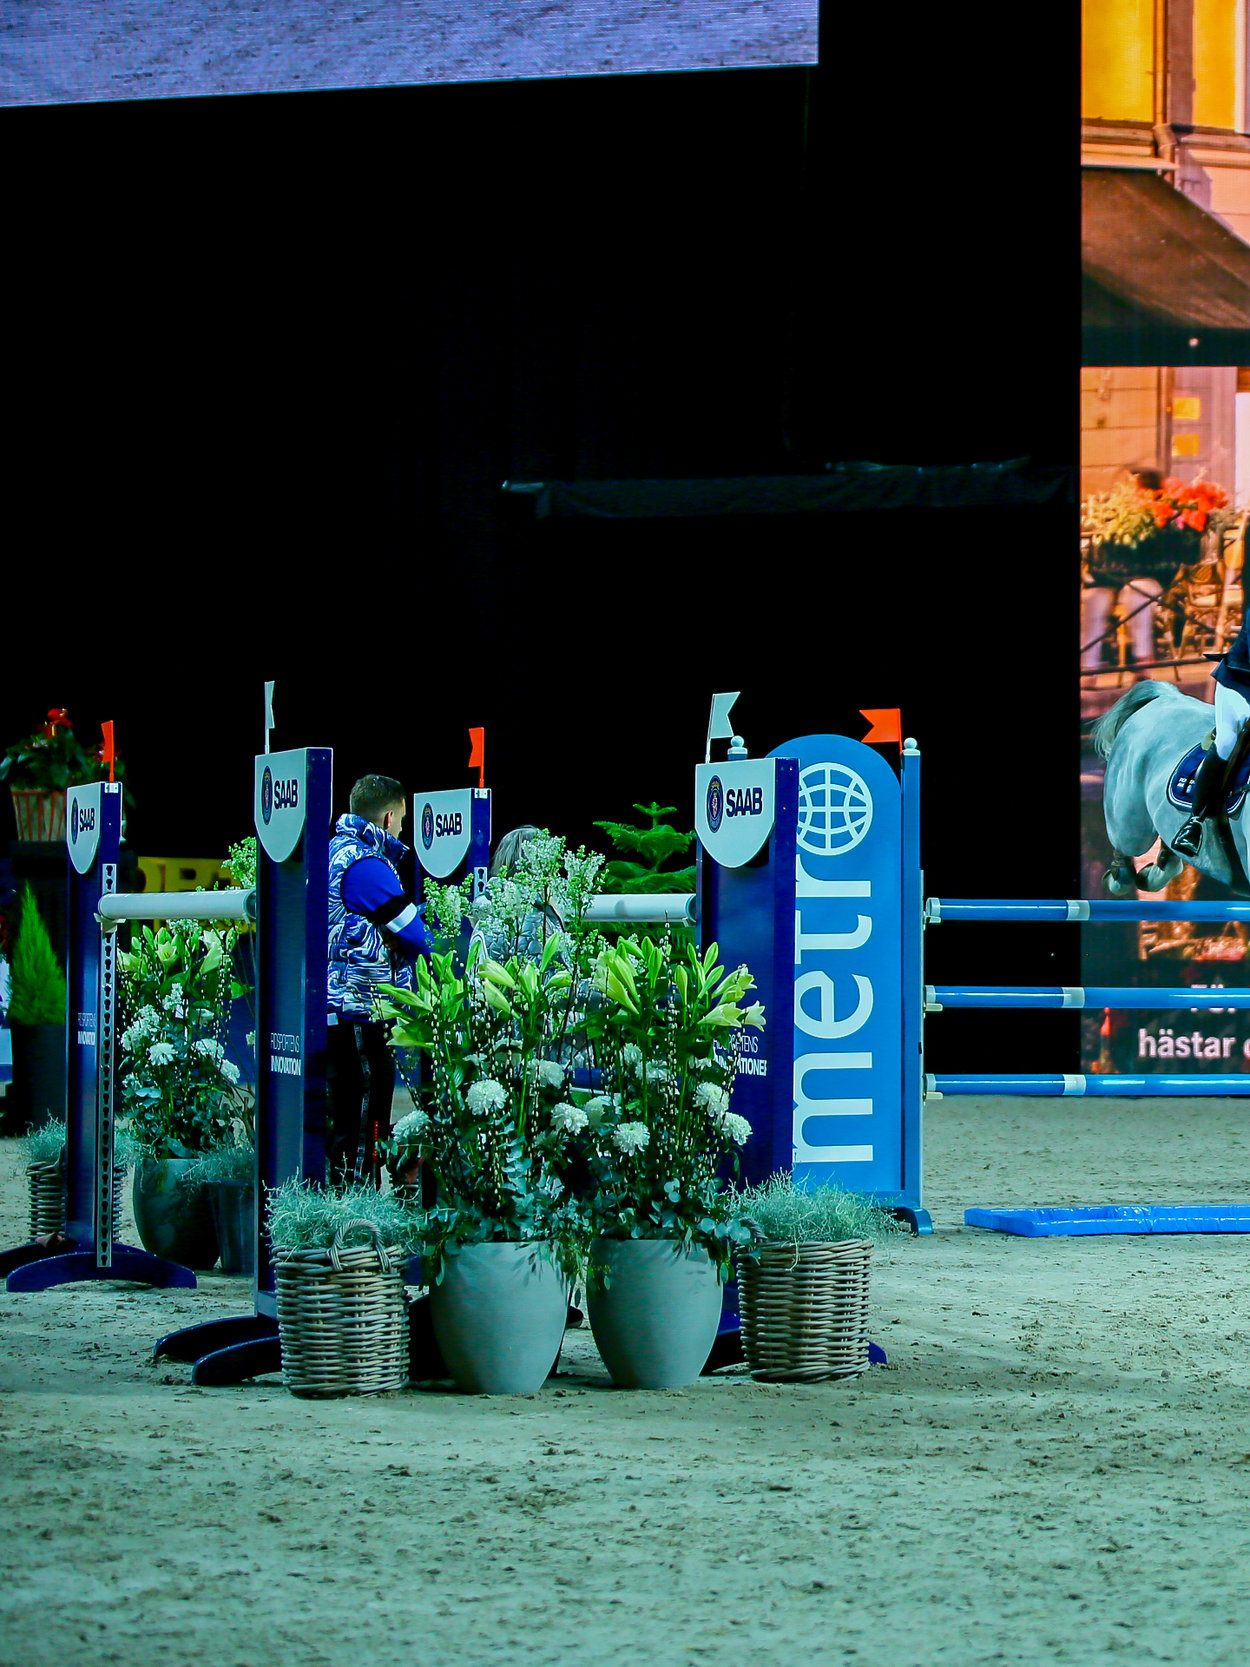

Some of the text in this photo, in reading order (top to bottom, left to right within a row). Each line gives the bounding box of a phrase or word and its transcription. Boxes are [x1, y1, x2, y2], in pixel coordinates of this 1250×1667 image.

[274, 779, 298, 810] SAAB
[726, 787, 762, 818] SAAB
[79, 807, 95, 832] SAAB
[435, 812, 462, 837] SAAB
[793, 762, 873, 1162] metro
[1138, 1028, 1236, 1058] hästar
